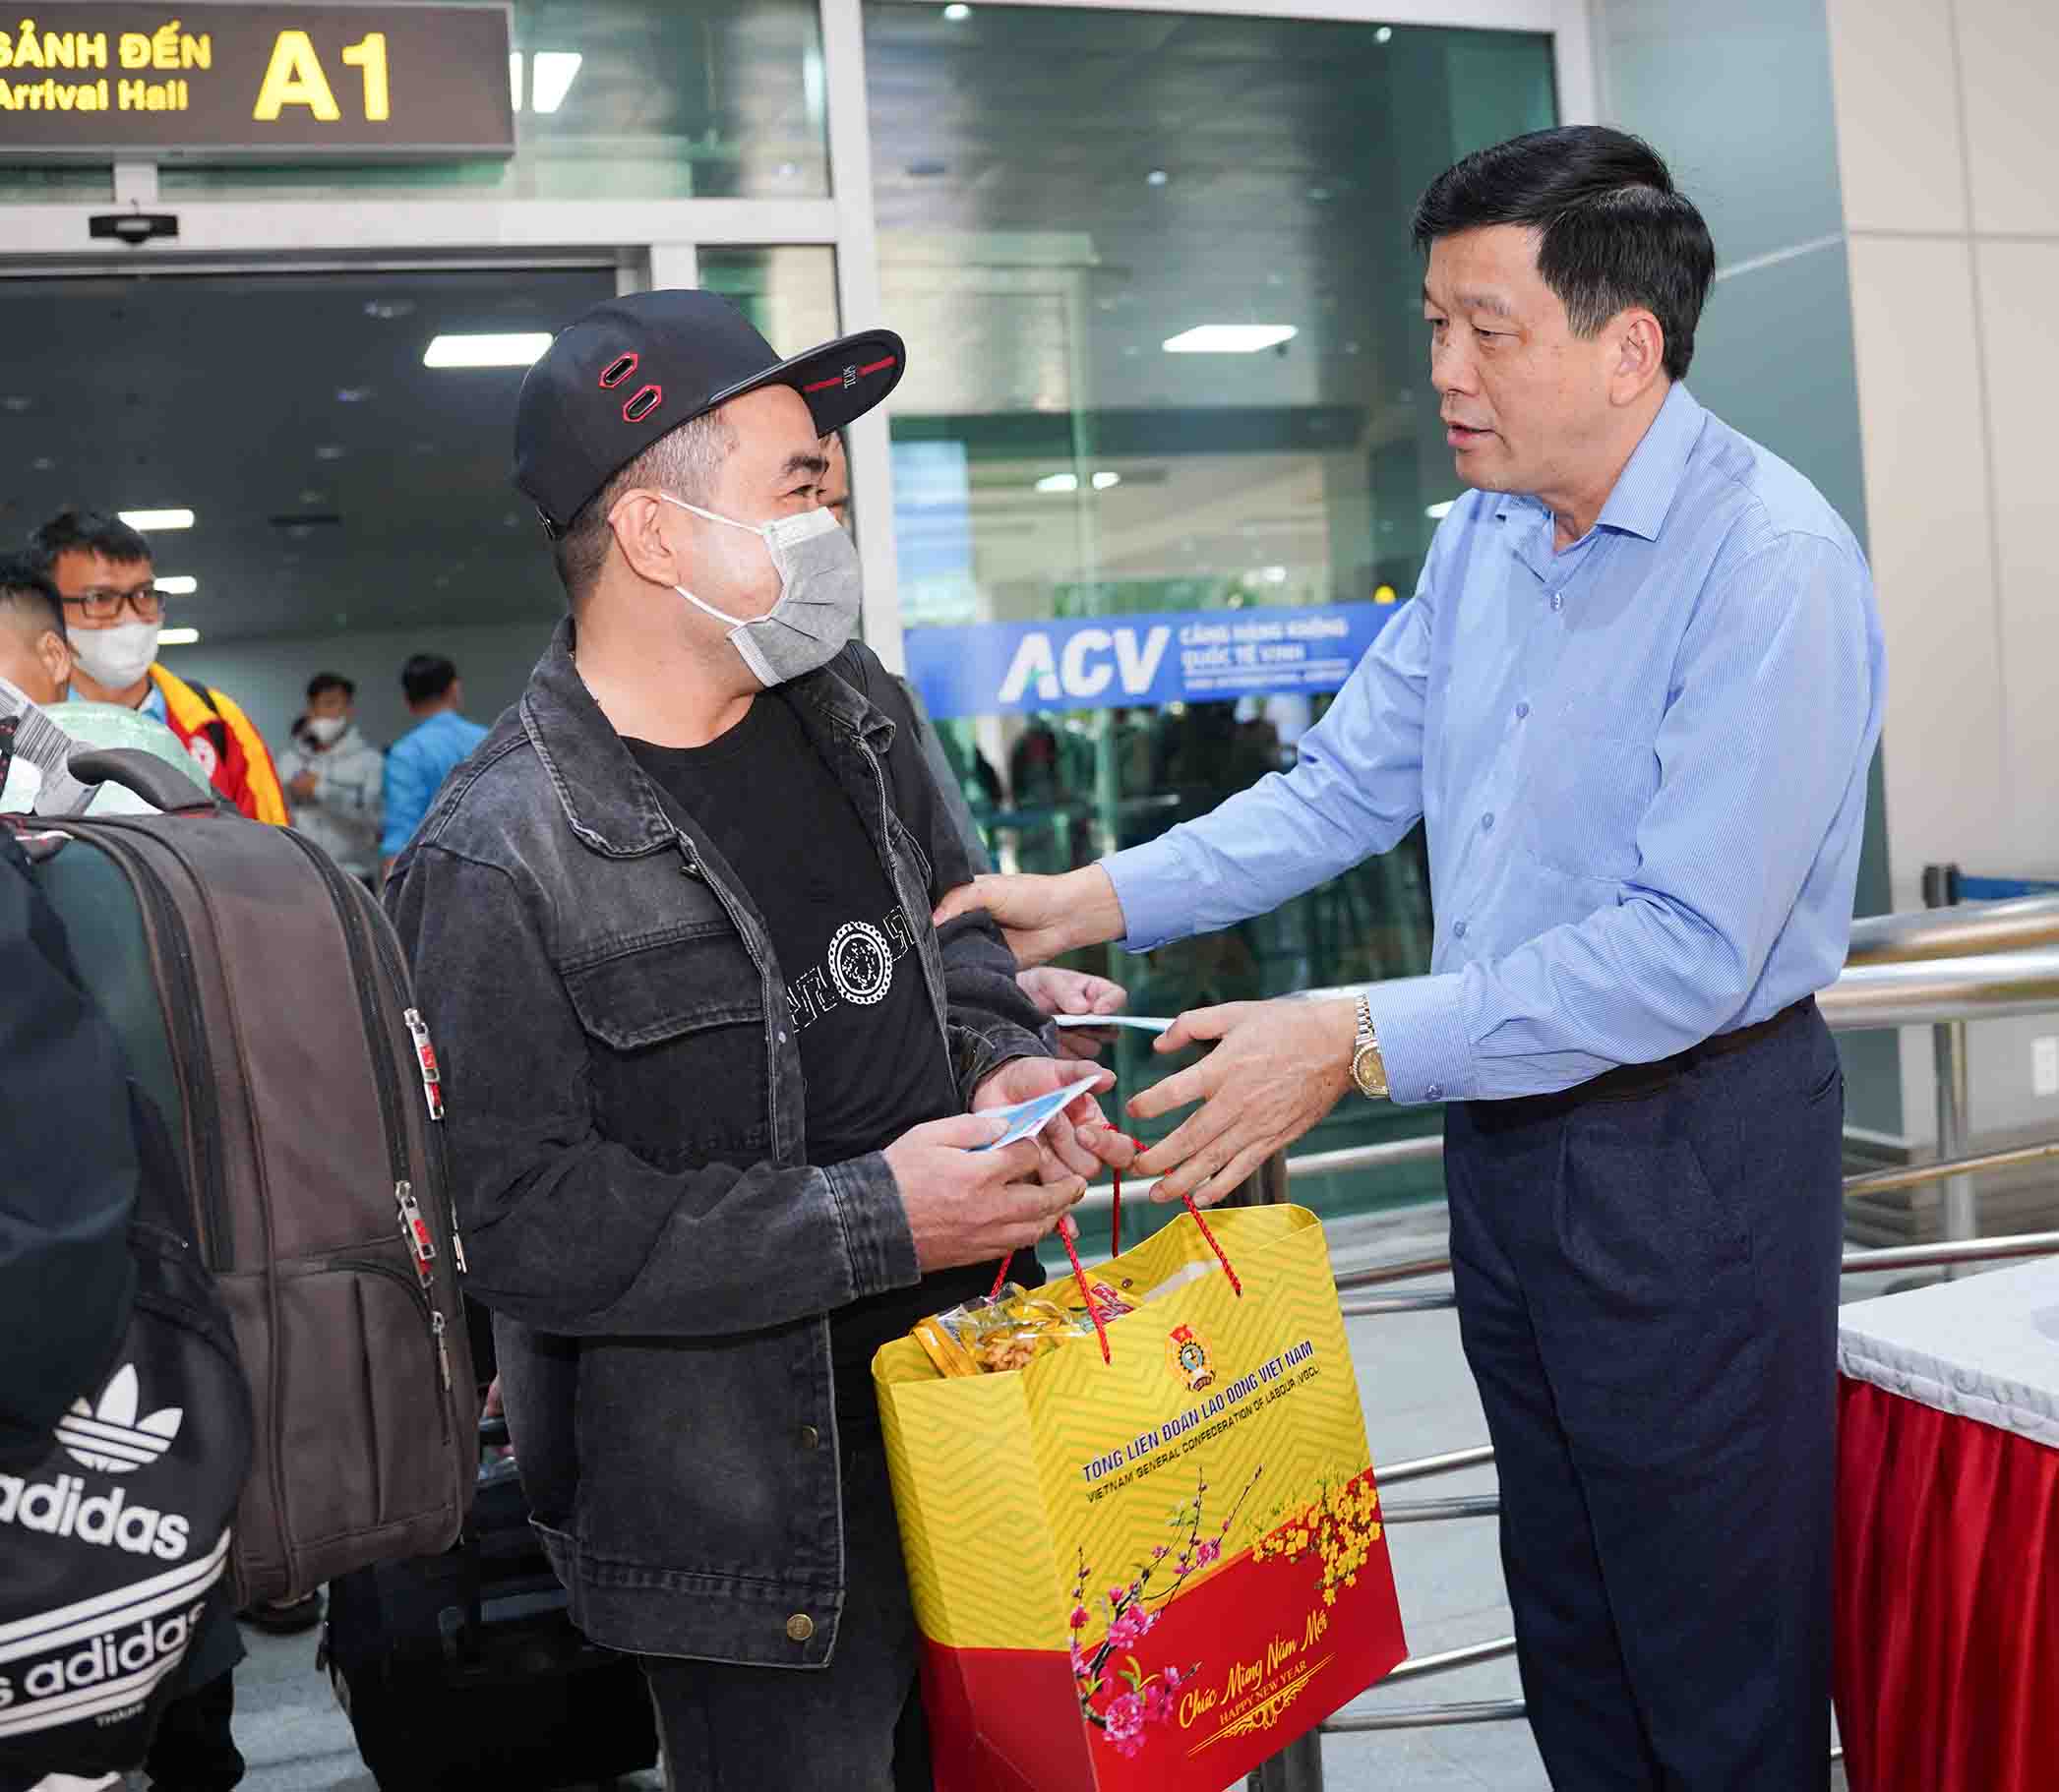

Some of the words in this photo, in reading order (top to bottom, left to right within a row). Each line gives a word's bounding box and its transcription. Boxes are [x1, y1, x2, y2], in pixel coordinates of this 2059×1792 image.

[118, 18, 212, 70] ĐẾN
[252, 30, 391, 121] A1
[117, 79, 189, 111] Hall
[998, 627, 1171, 704] ACV
[1201, 1394, 1225, 1419] LAO
[1285, 1340, 1313, 1368] NAM
[1086, 1471, 1133, 1503] VIETNAM
[1136, 1448, 1181, 1478] GENERAL
[1181, 1405, 1252, 1454] CONFEDERATION
[1253, 1398, 1265, 1411] OF
[1266, 1378, 1296, 1404] LABOUR
[1220, 1699, 1252, 1725] HAPPY
[1252, 1677, 1279, 1702] NEW
[1280, 1660, 1307, 1685] YEAR
